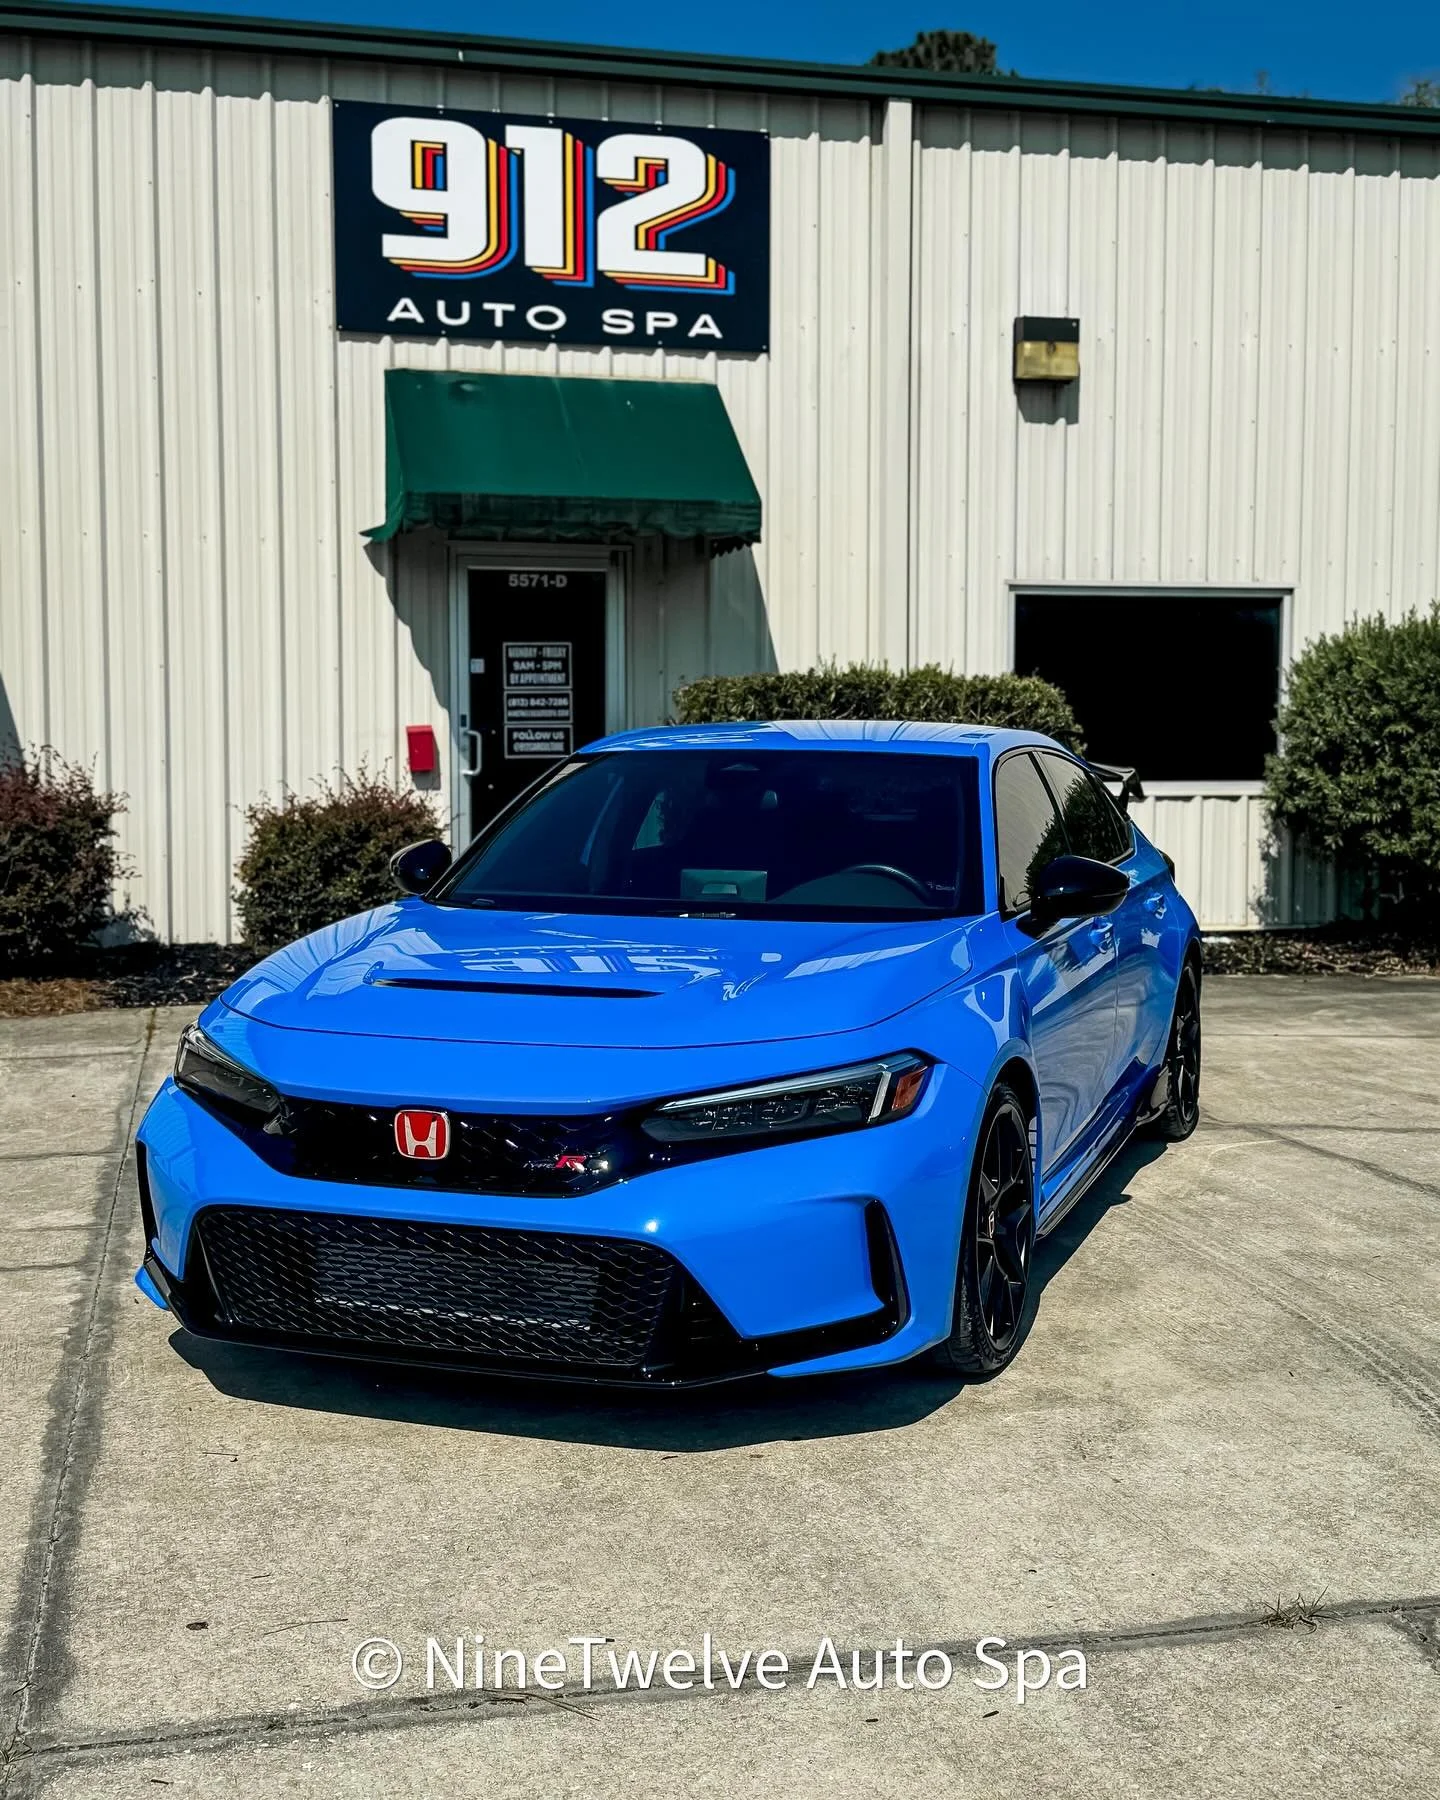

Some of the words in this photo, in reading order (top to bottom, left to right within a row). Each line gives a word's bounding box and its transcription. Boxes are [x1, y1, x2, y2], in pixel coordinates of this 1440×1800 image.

[371, 117, 735, 295] 912
[387, 298, 567, 331] AUTO
[602, 308, 723, 339] SPA
[508, 574, 568, 588] 5571-D
[513, 661, 535, 671] 9AM
